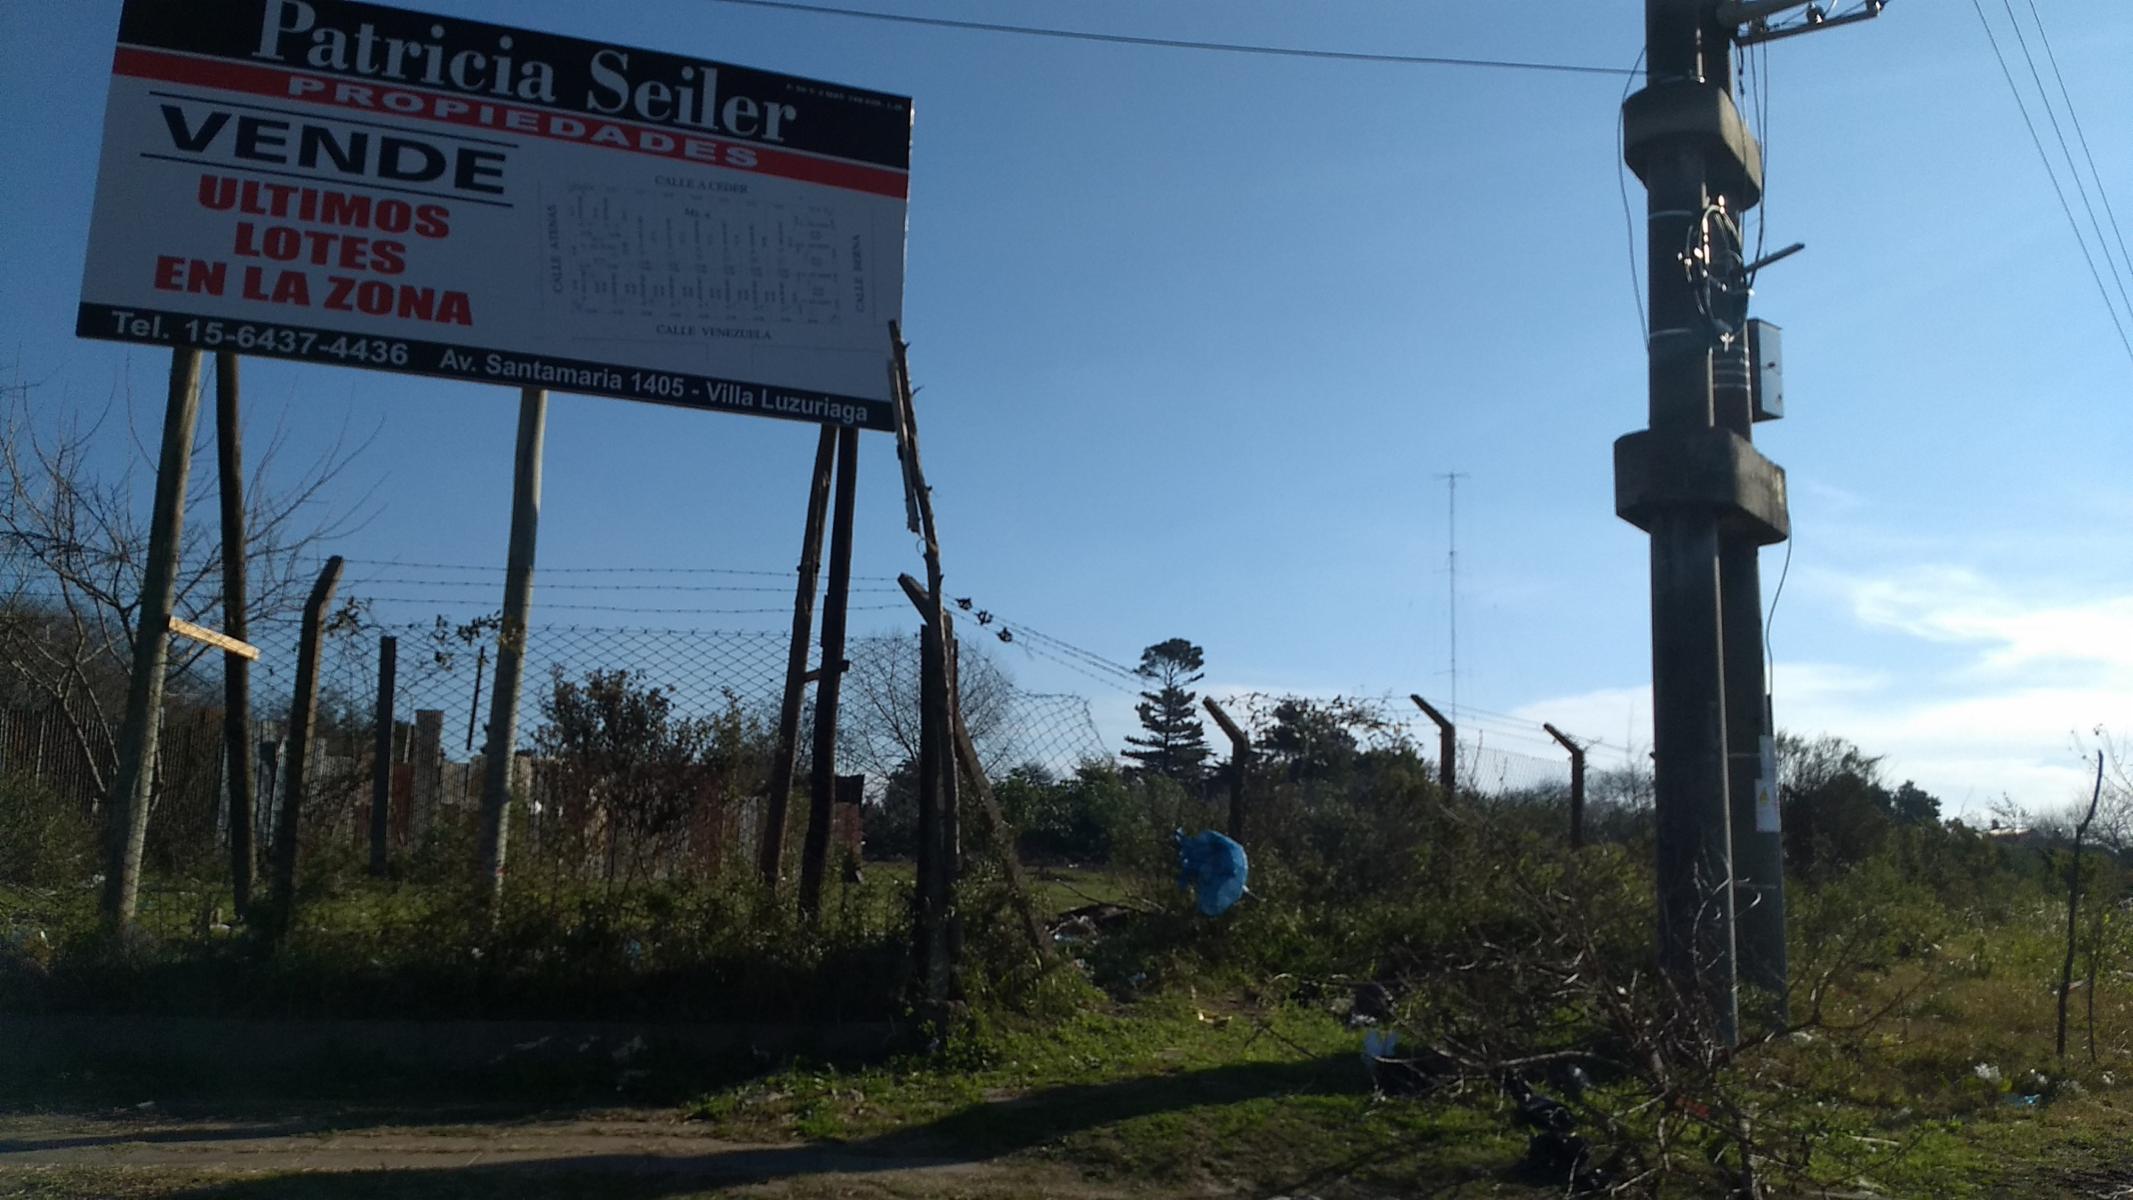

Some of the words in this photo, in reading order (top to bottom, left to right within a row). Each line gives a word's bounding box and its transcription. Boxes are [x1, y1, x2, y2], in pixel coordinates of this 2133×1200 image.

[251, 0, 557, 103] Patricia
[586, 50, 797, 144] Seiler
[160, 104, 505, 196] VENDE
[287, 75, 760, 169] PROPIEDADES
[198, 175, 450, 240] ULTIMOS
[234, 221, 407, 276] LOTES
[155, 257, 225, 297] EN
[242, 265, 311, 308] LA
[324, 276, 472, 326] ZONA
[112, 311, 169, 342] Tel.
[184, 318, 409, 367] 15-6437-4436
[439, 349, 478, 374] Av.
[486, 354, 622, 390] Santamaria
[631, 368, 684, 398] 1405
[706, 380, 753, 406] Villa
[761, 388, 868, 422] Luzuriaga
